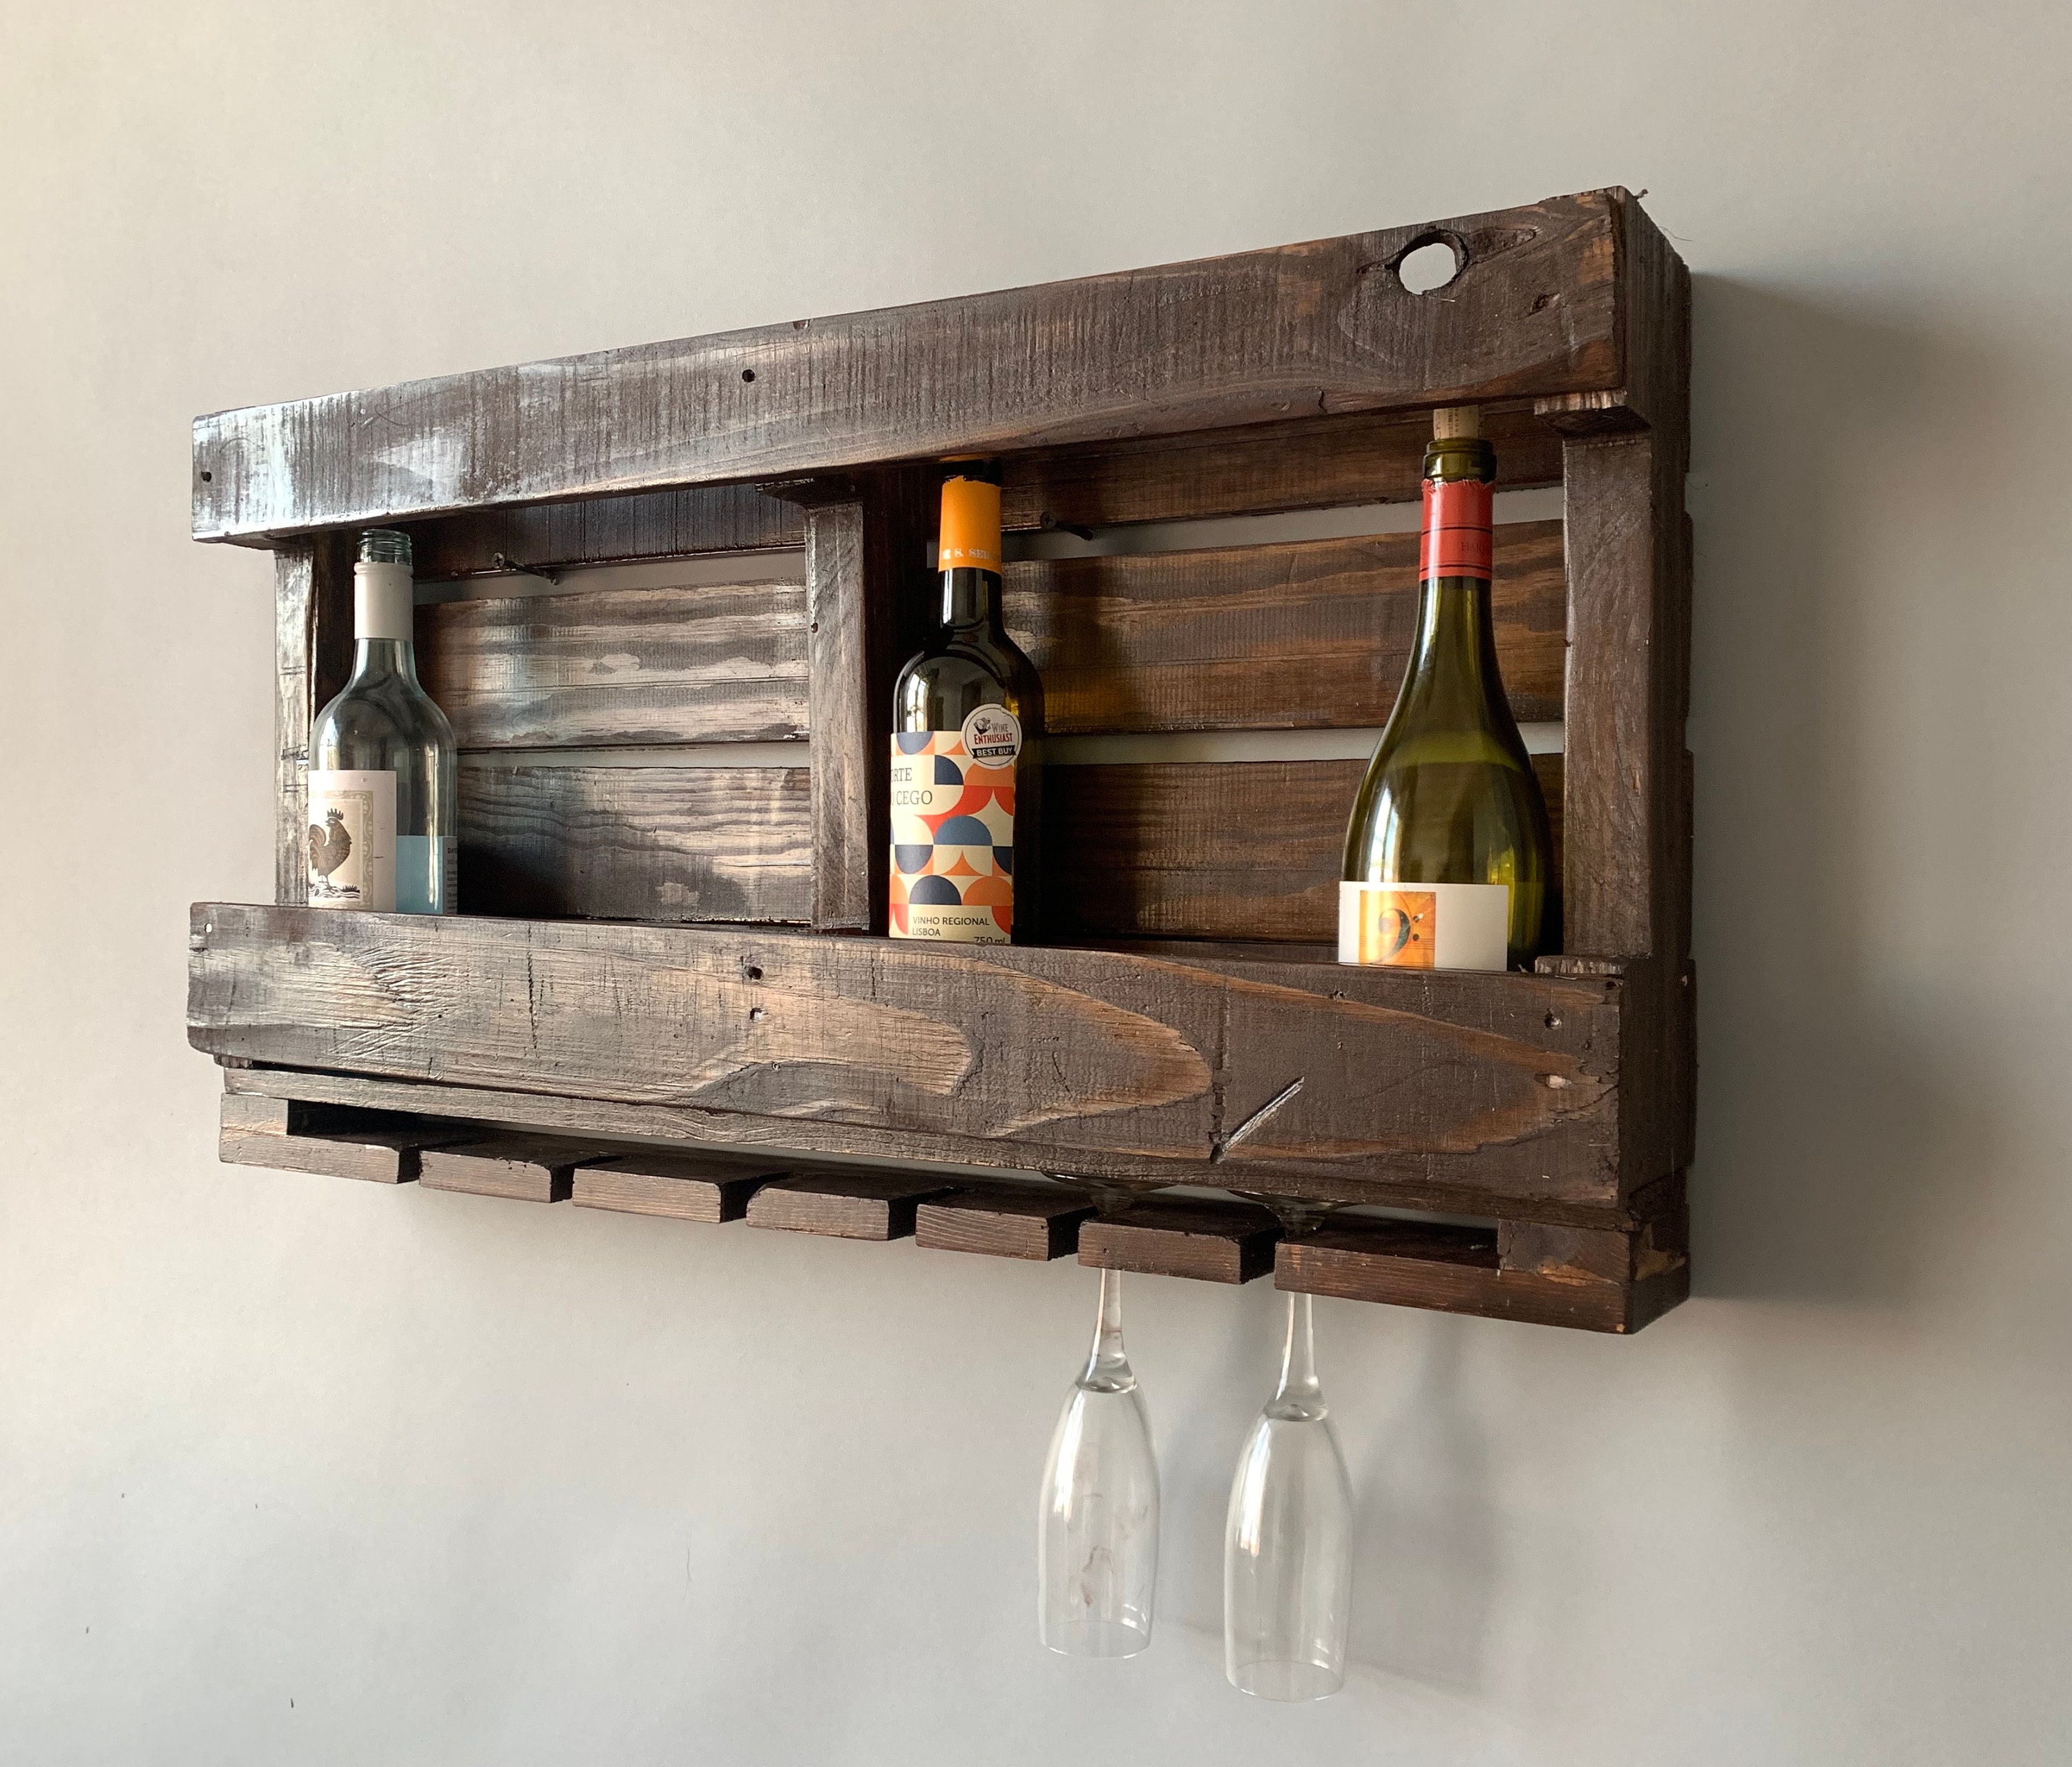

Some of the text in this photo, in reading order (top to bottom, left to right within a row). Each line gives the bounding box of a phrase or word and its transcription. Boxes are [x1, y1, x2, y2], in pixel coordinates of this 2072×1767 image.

[991, 722, 1008, 733] WINE
[974, 733, 1013, 744] ENTHUSIAST
[977, 748, 997, 757] BEST
[896, 790, 932, 805] CEGO
[912, 916, 990, 926] VINHO REGIONAL
[912, 928, 941, 936] LISBOA
